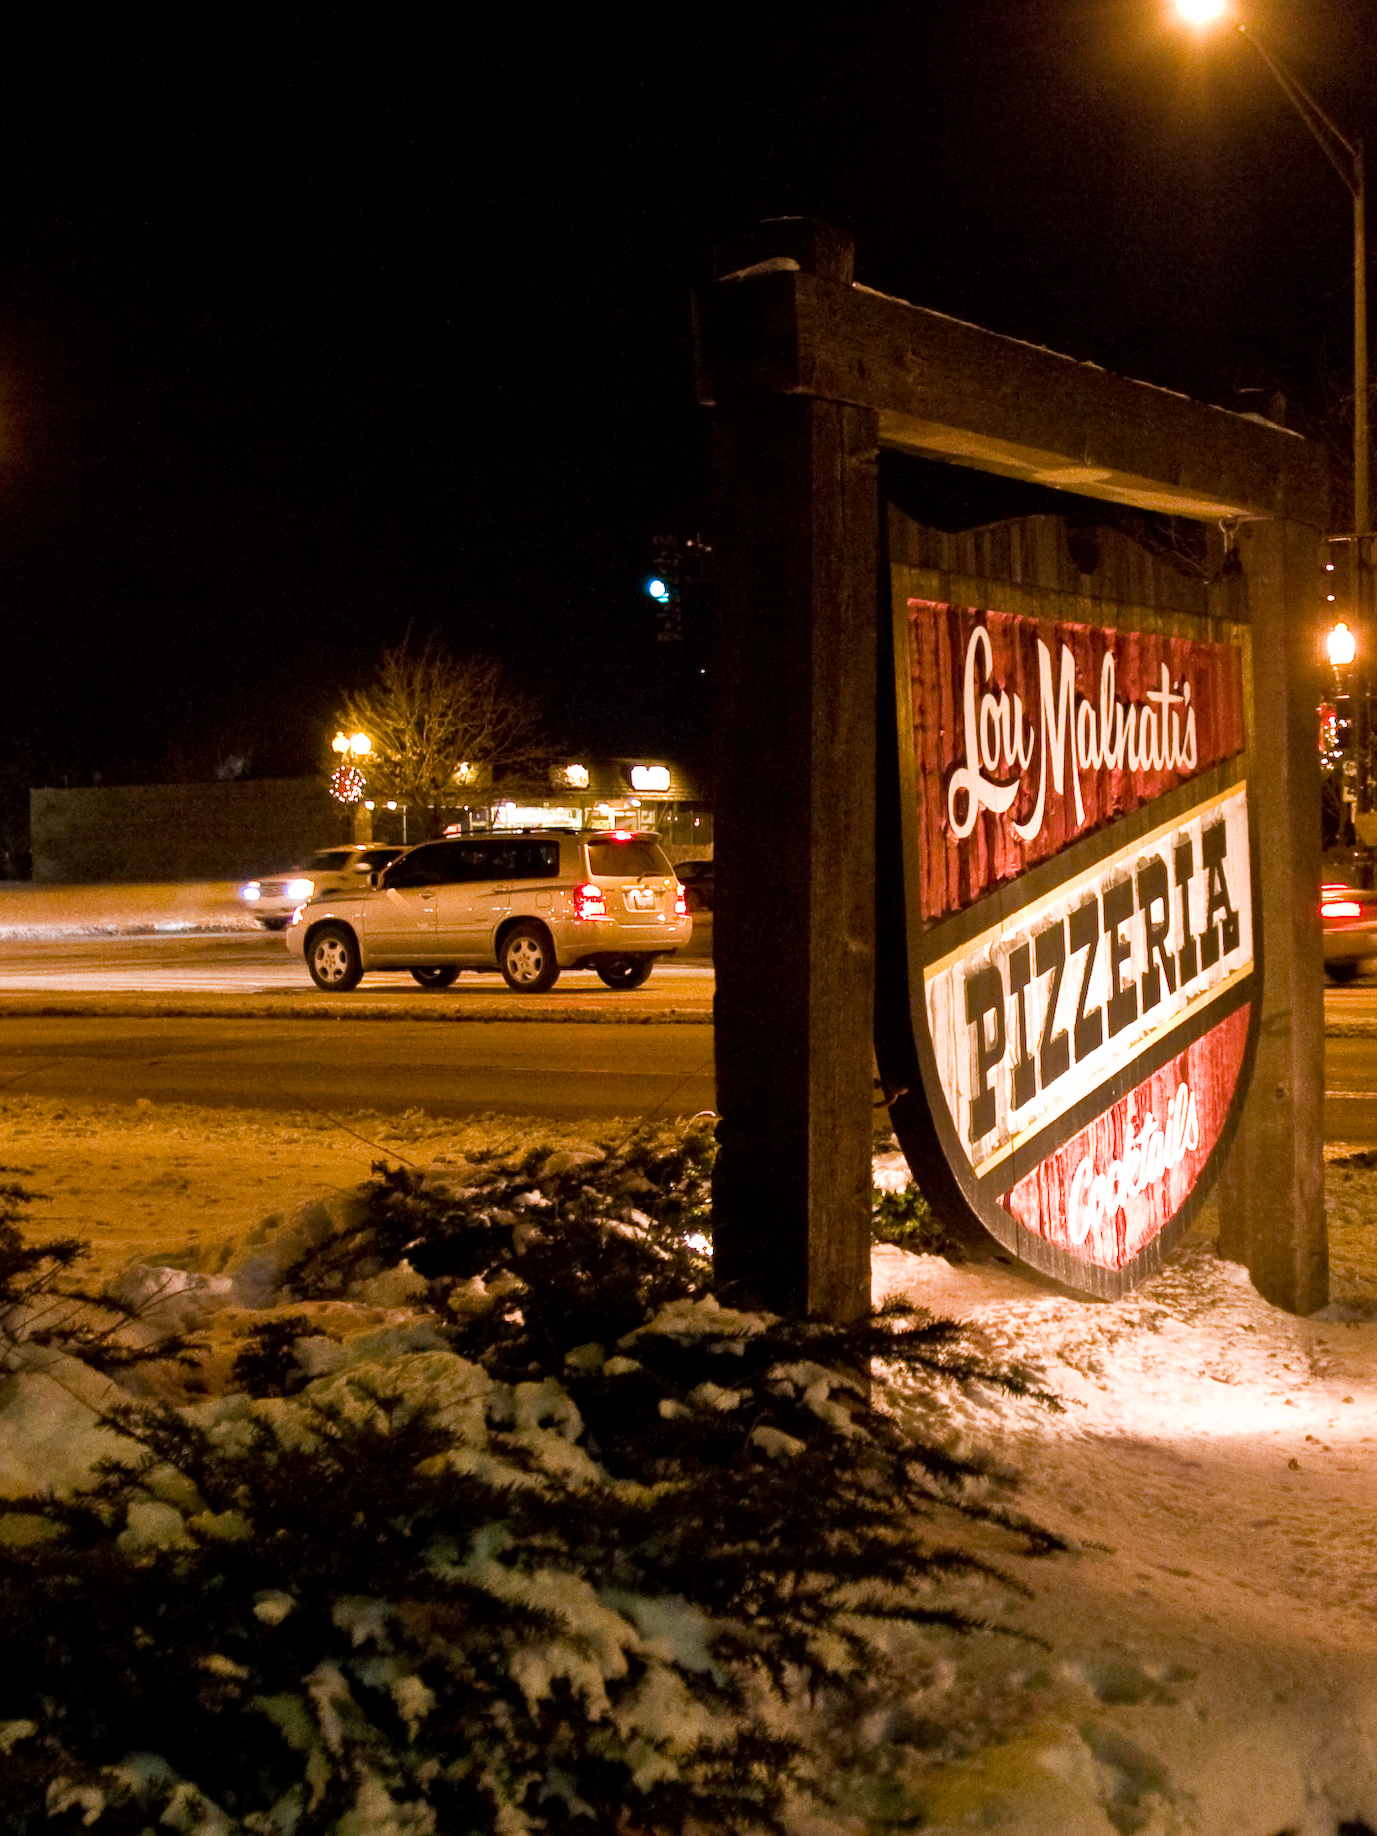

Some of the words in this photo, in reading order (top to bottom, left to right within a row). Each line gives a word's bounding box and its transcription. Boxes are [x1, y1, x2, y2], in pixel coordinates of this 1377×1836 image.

[948, 625, 1035, 839] Lou
[1014, 638, 1197, 840] Malnati's
[964, 821, 1241, 1145] PIZZERIA
[1068, 1082, 1200, 1245] Cocktails
